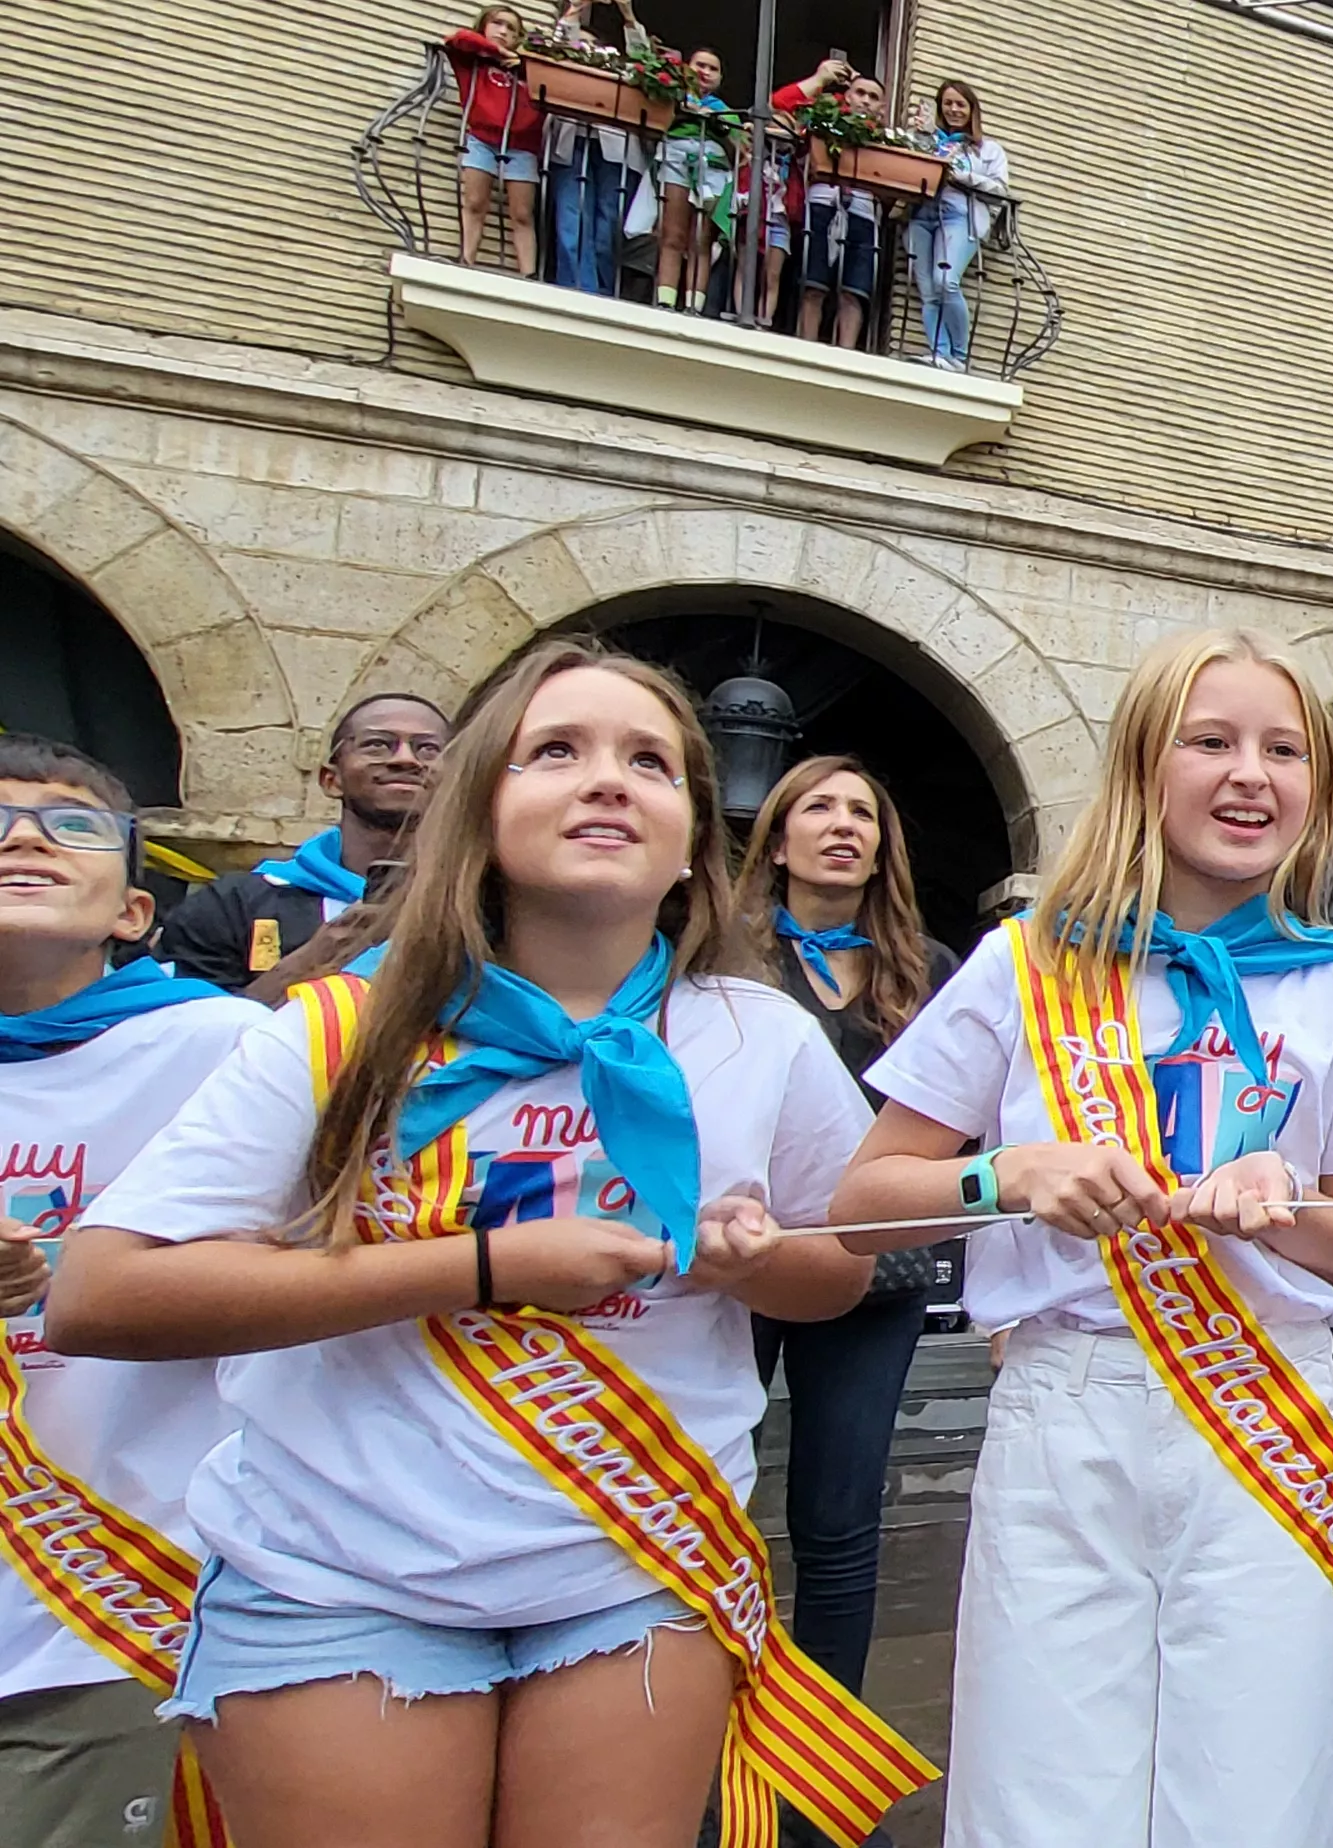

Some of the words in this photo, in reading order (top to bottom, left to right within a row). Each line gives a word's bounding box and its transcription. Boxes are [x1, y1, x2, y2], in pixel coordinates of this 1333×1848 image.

[0, 1143, 86, 1238] uy
[490, 1328, 706, 1569] Monzón
[8, 1465, 191, 1666] Monzó
